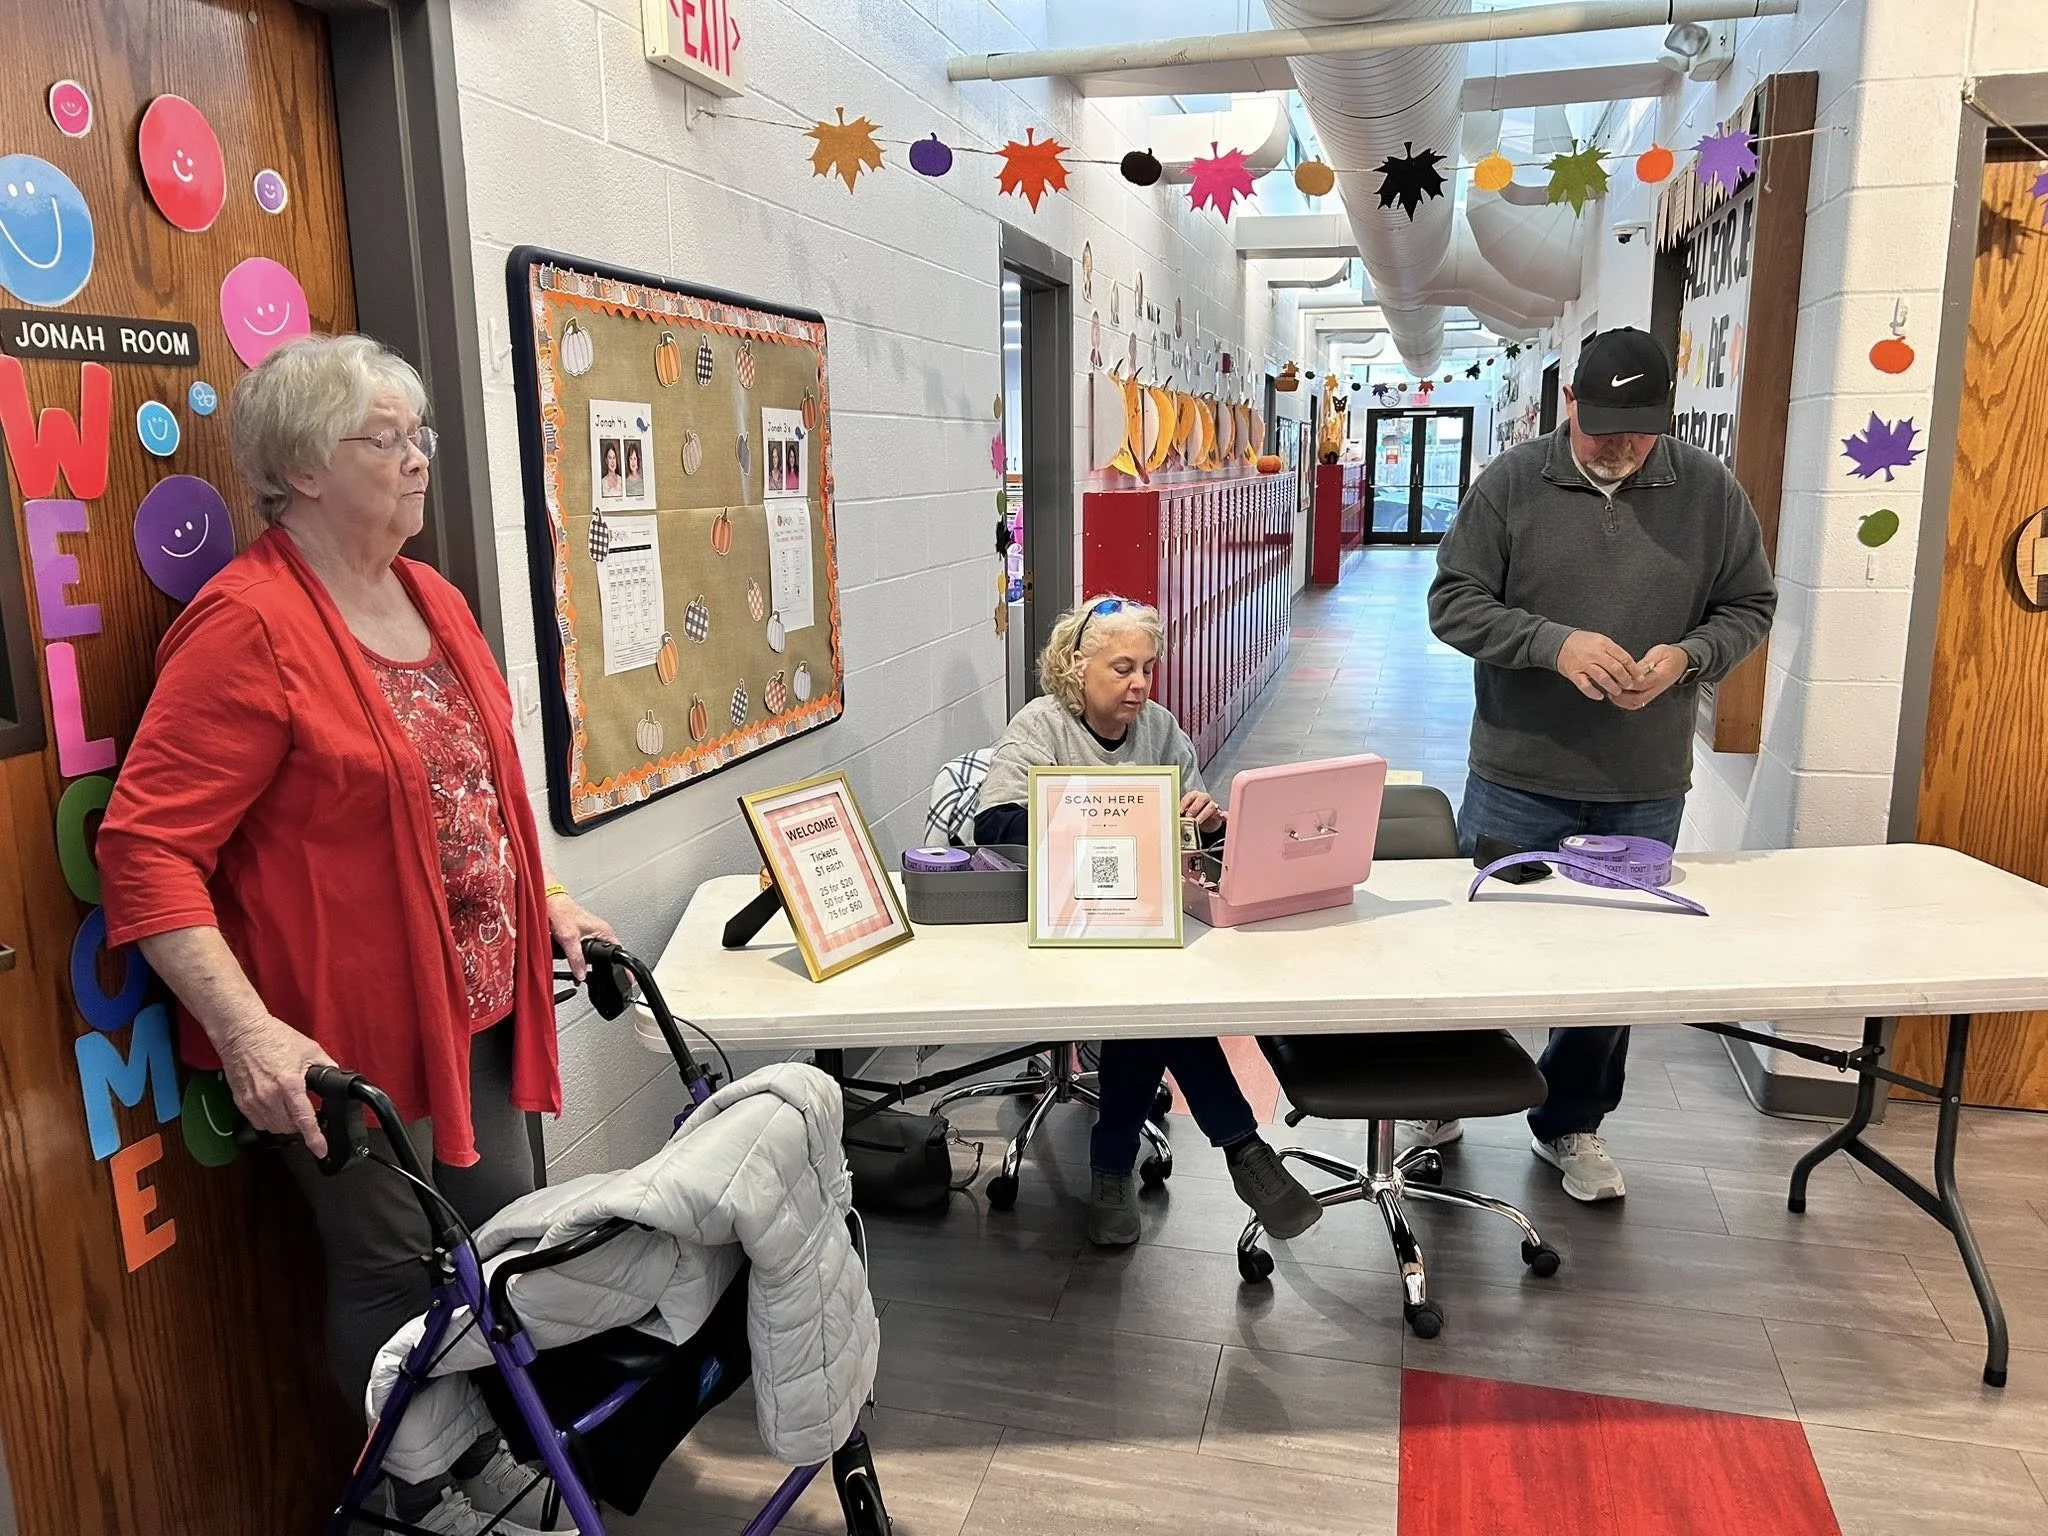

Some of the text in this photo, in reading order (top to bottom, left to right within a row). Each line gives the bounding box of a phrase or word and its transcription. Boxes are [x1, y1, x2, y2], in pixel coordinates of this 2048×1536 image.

[15, 321, 190, 356] JONAH ROOM
[595, 414, 615, 428] Jonah
[768, 421, 783, 433] Jonah
[1064, 795, 1145, 804] SCAN HERE
[1080, 808, 1129, 817] TO PAY
[786, 816, 838, 841] WELCOME!
[810, 847, 838, 863] Tickets
[826, 860, 844, 872] each
[1630, 865, 1648, 873] TICKET
[820, 886, 829, 897] 25
[840, 877, 853, 889] $20
[824, 898, 833, 908] 50
[845, 888, 858, 900] $40
[829, 910, 838, 920] 75
[849, 900, 862, 912] $60
